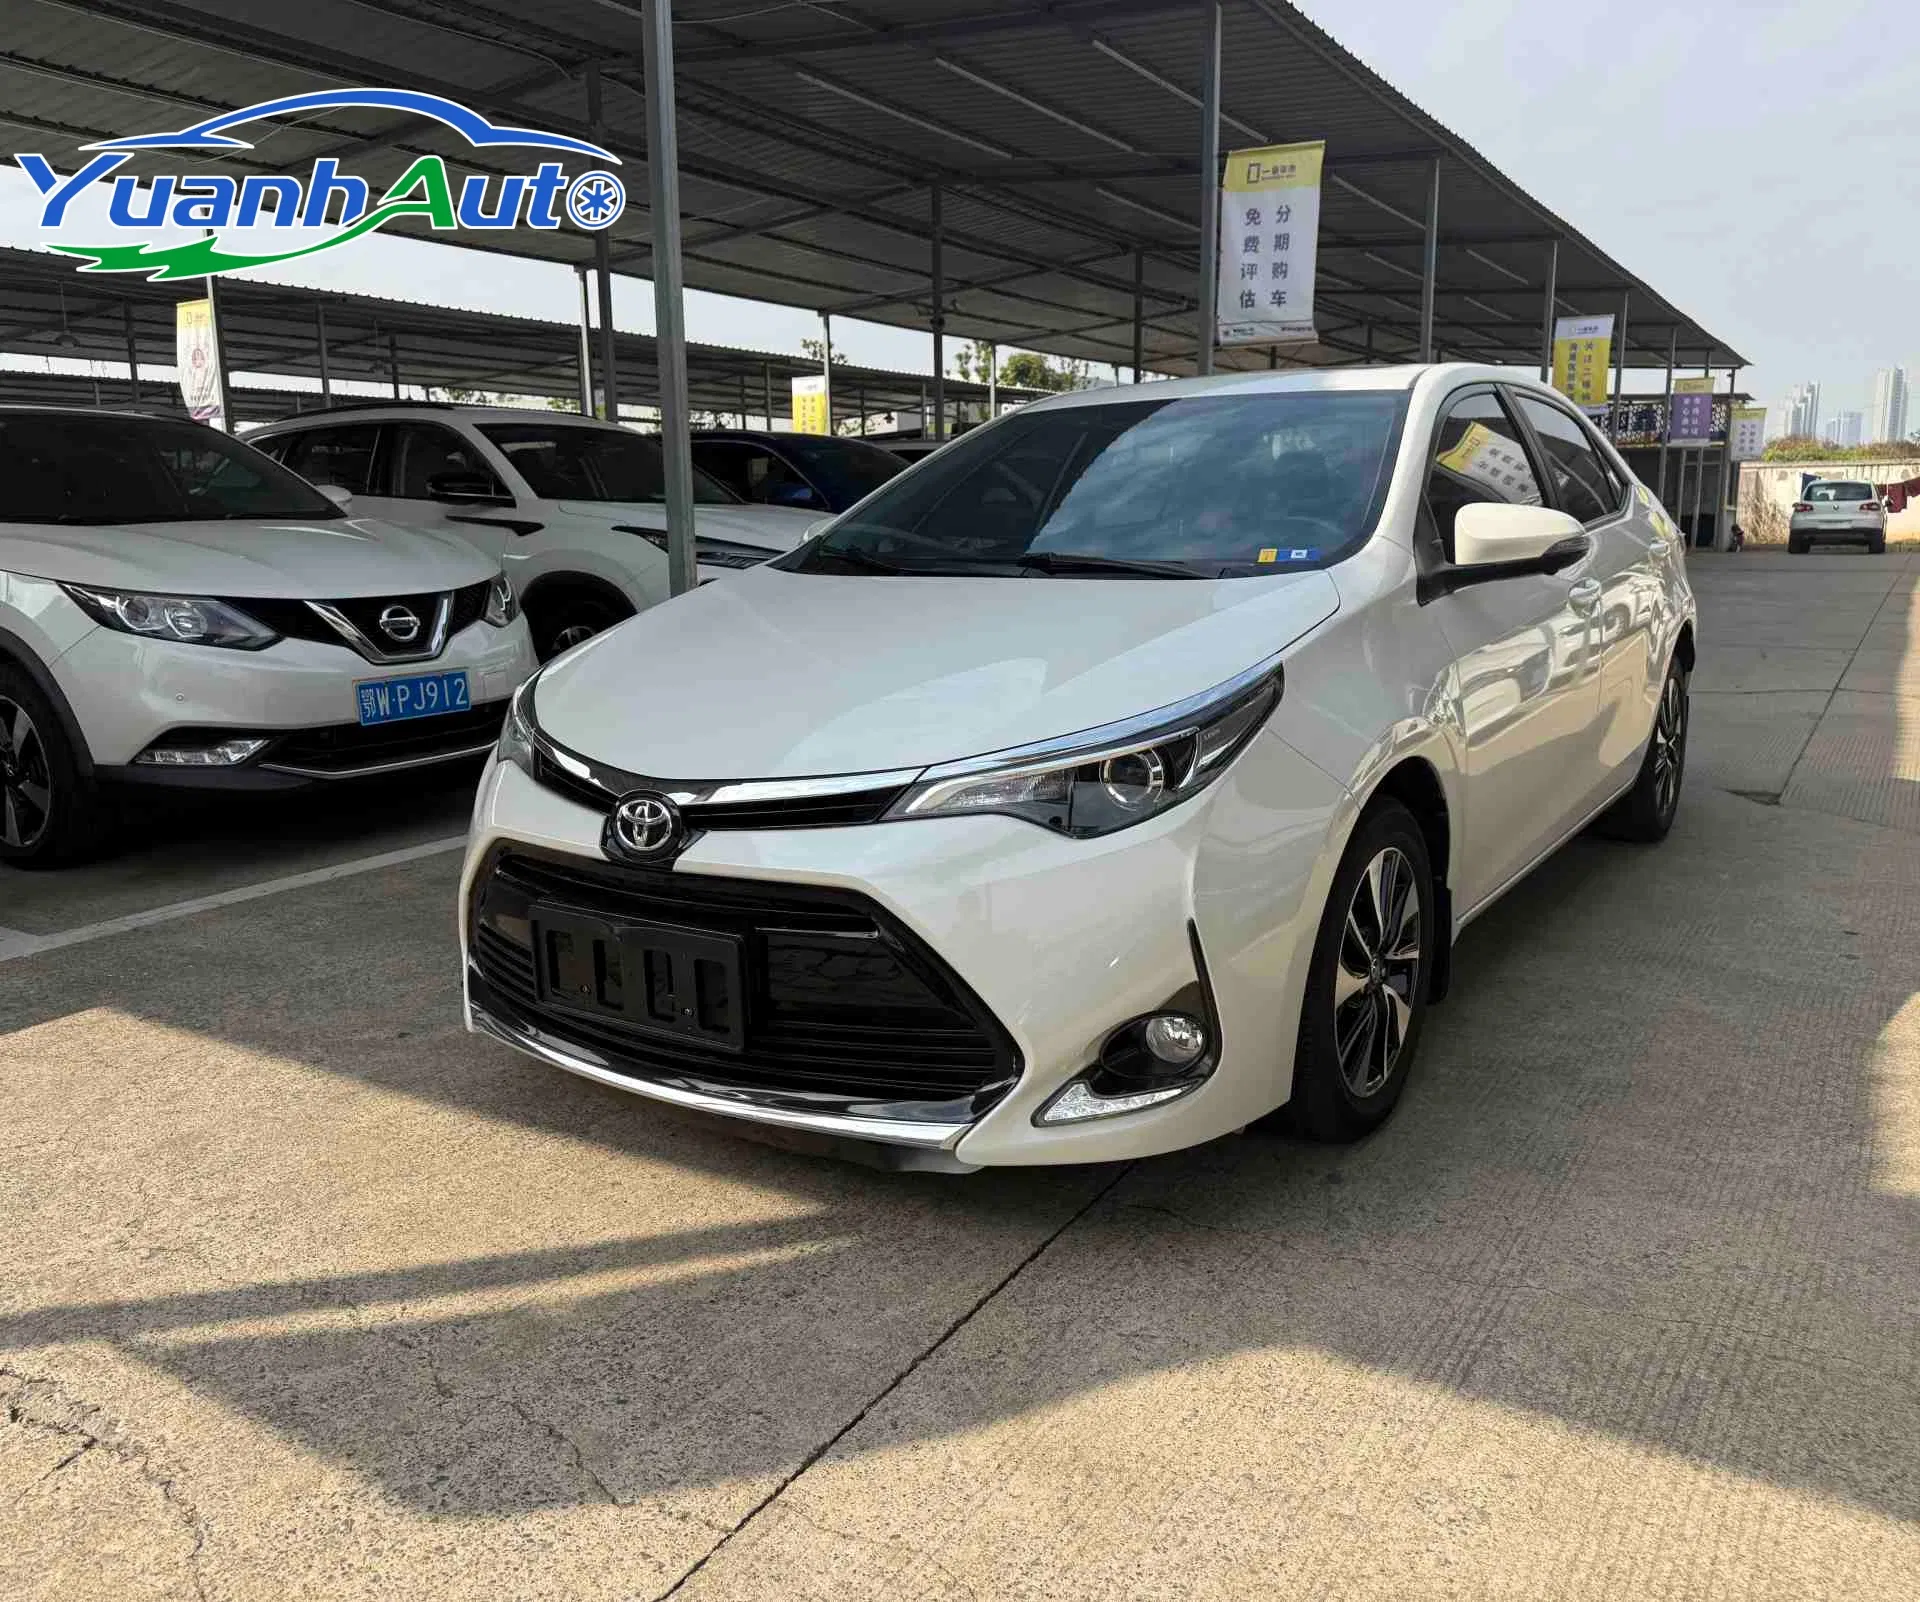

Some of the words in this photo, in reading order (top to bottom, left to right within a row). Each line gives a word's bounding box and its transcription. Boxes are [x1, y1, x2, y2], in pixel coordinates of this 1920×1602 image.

[1239, 207, 1261, 309] 免费评估
[1270, 204, 1292, 307] 分期购车
